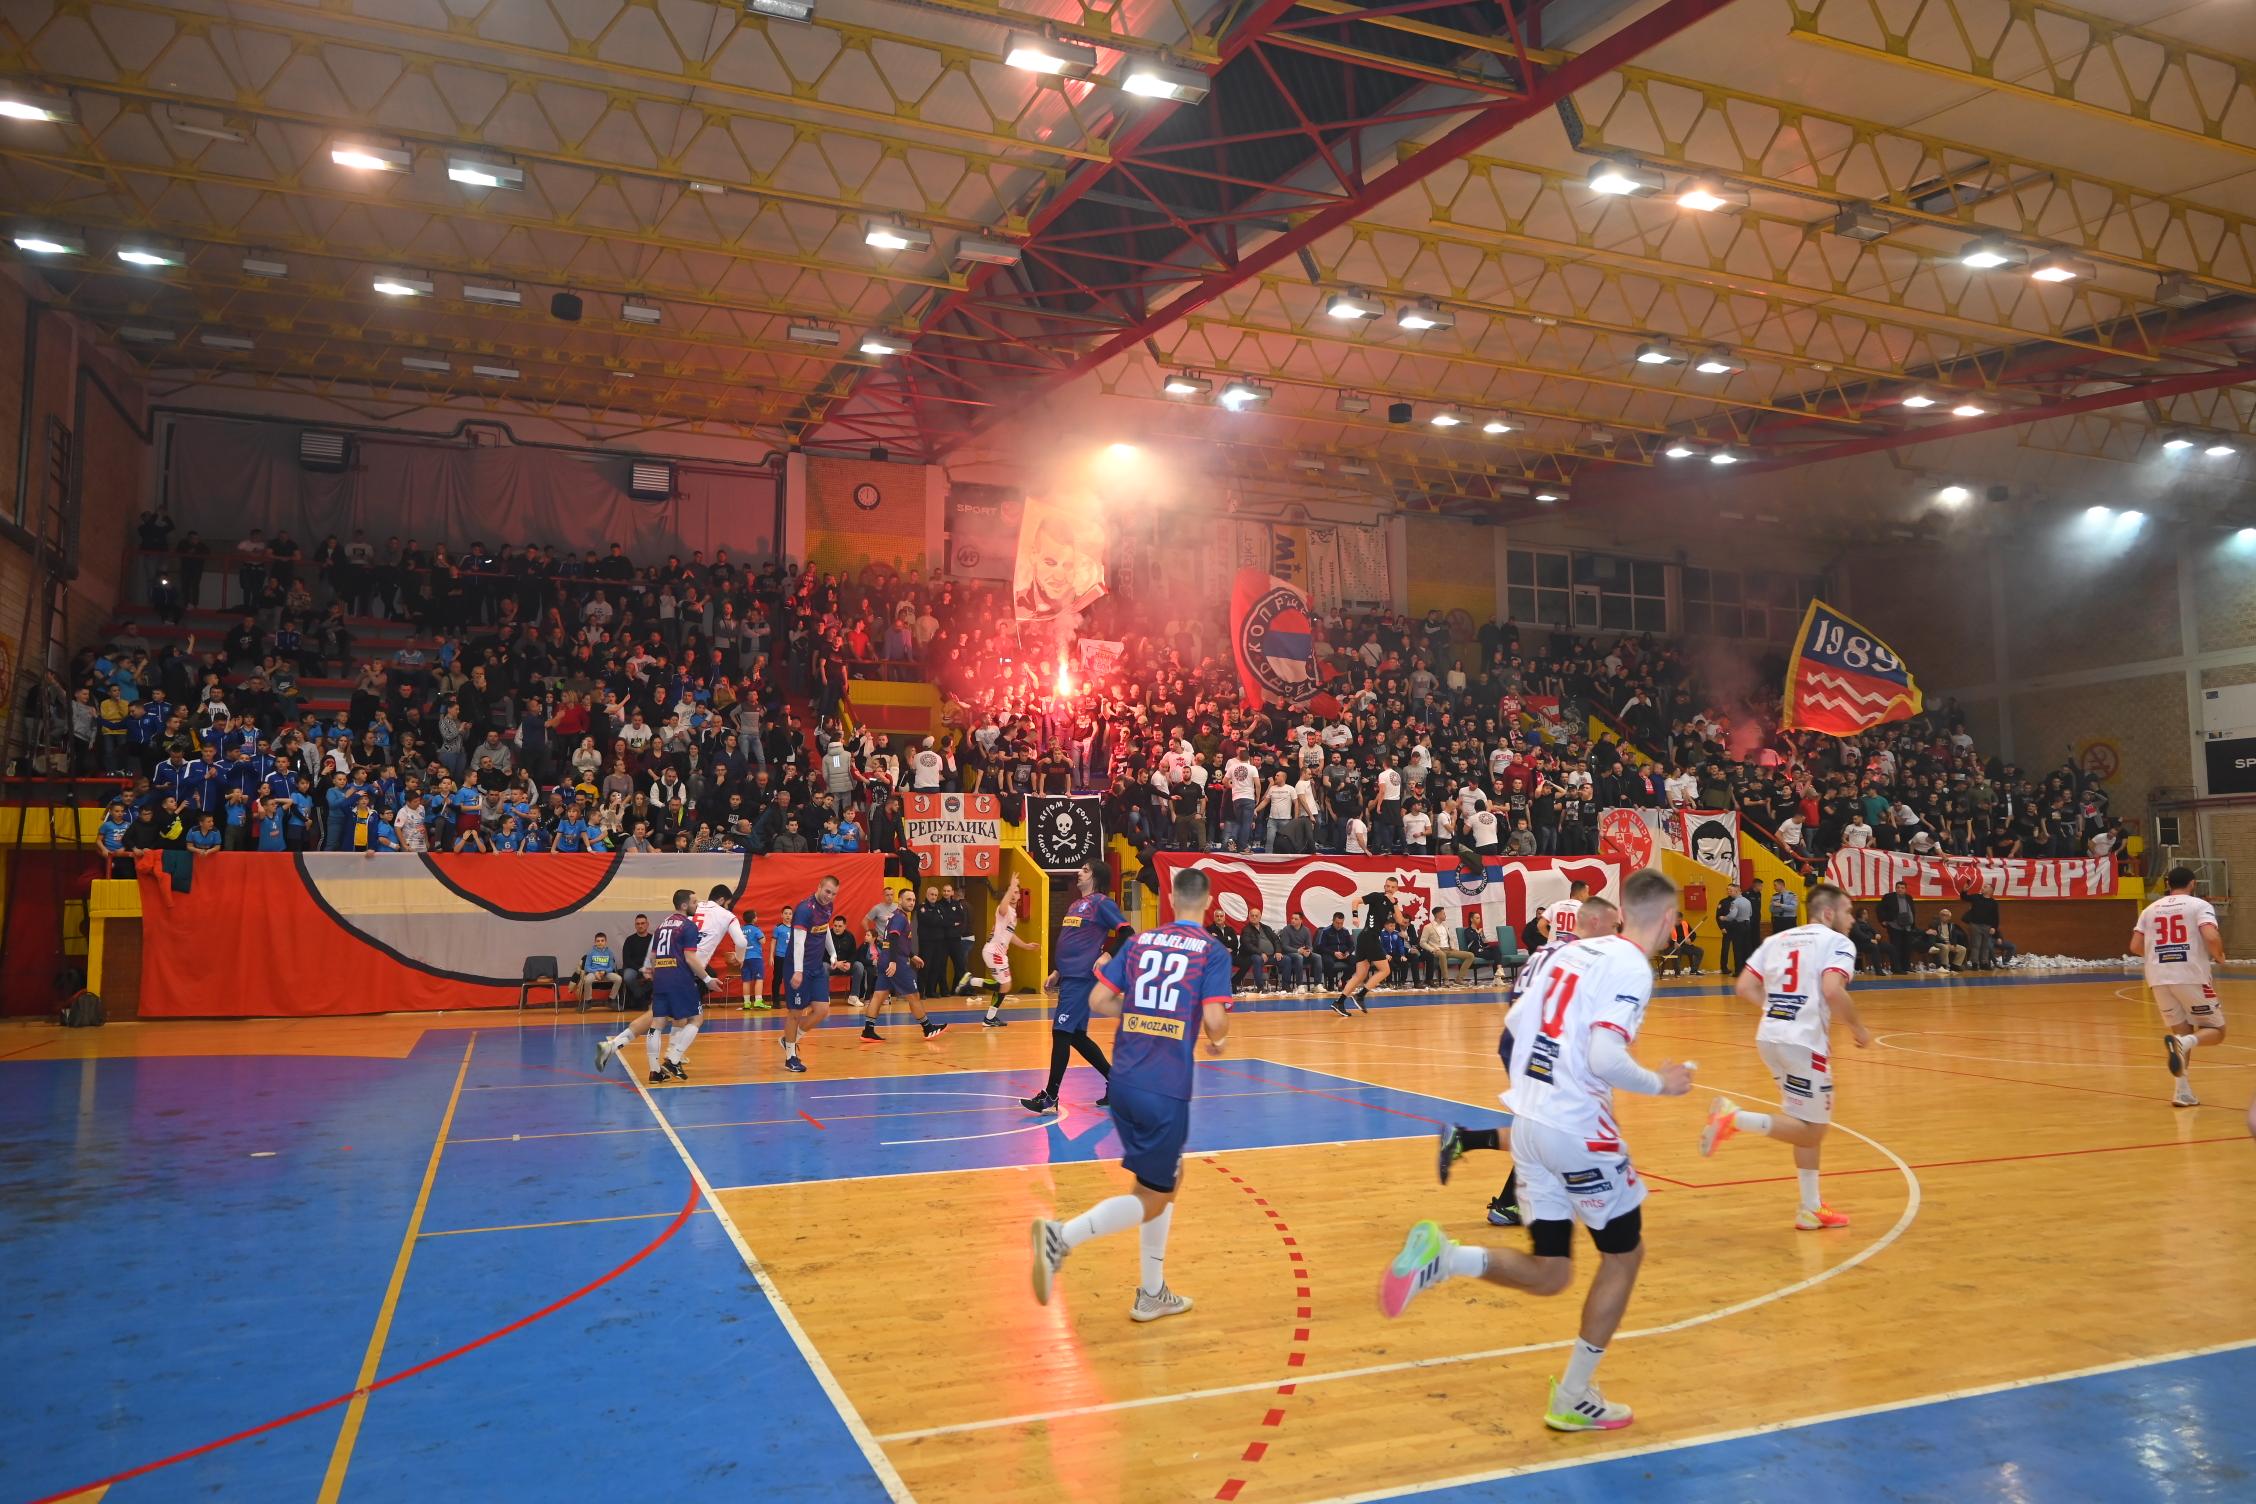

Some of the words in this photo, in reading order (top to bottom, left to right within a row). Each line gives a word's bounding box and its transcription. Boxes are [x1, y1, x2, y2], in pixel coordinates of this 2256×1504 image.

[956, 503, 998, 515] SPORT
[1813, 619, 1899, 673] 1989
[908, 820, 998, 840] РЕПУБЛИКА
[930, 833, 977, 844] СРПСКА
[1556, 911, 1576, 932] 90
[2154, 914, 2188, 946] 36
[656, 928, 673, 956] 21
[1134, 949, 1189, 1012] 22
[1782, 949, 1800, 993] 3
[1140, 1020, 1180, 1035] MOZZART
[1580, 1199, 1605, 1209] mts
